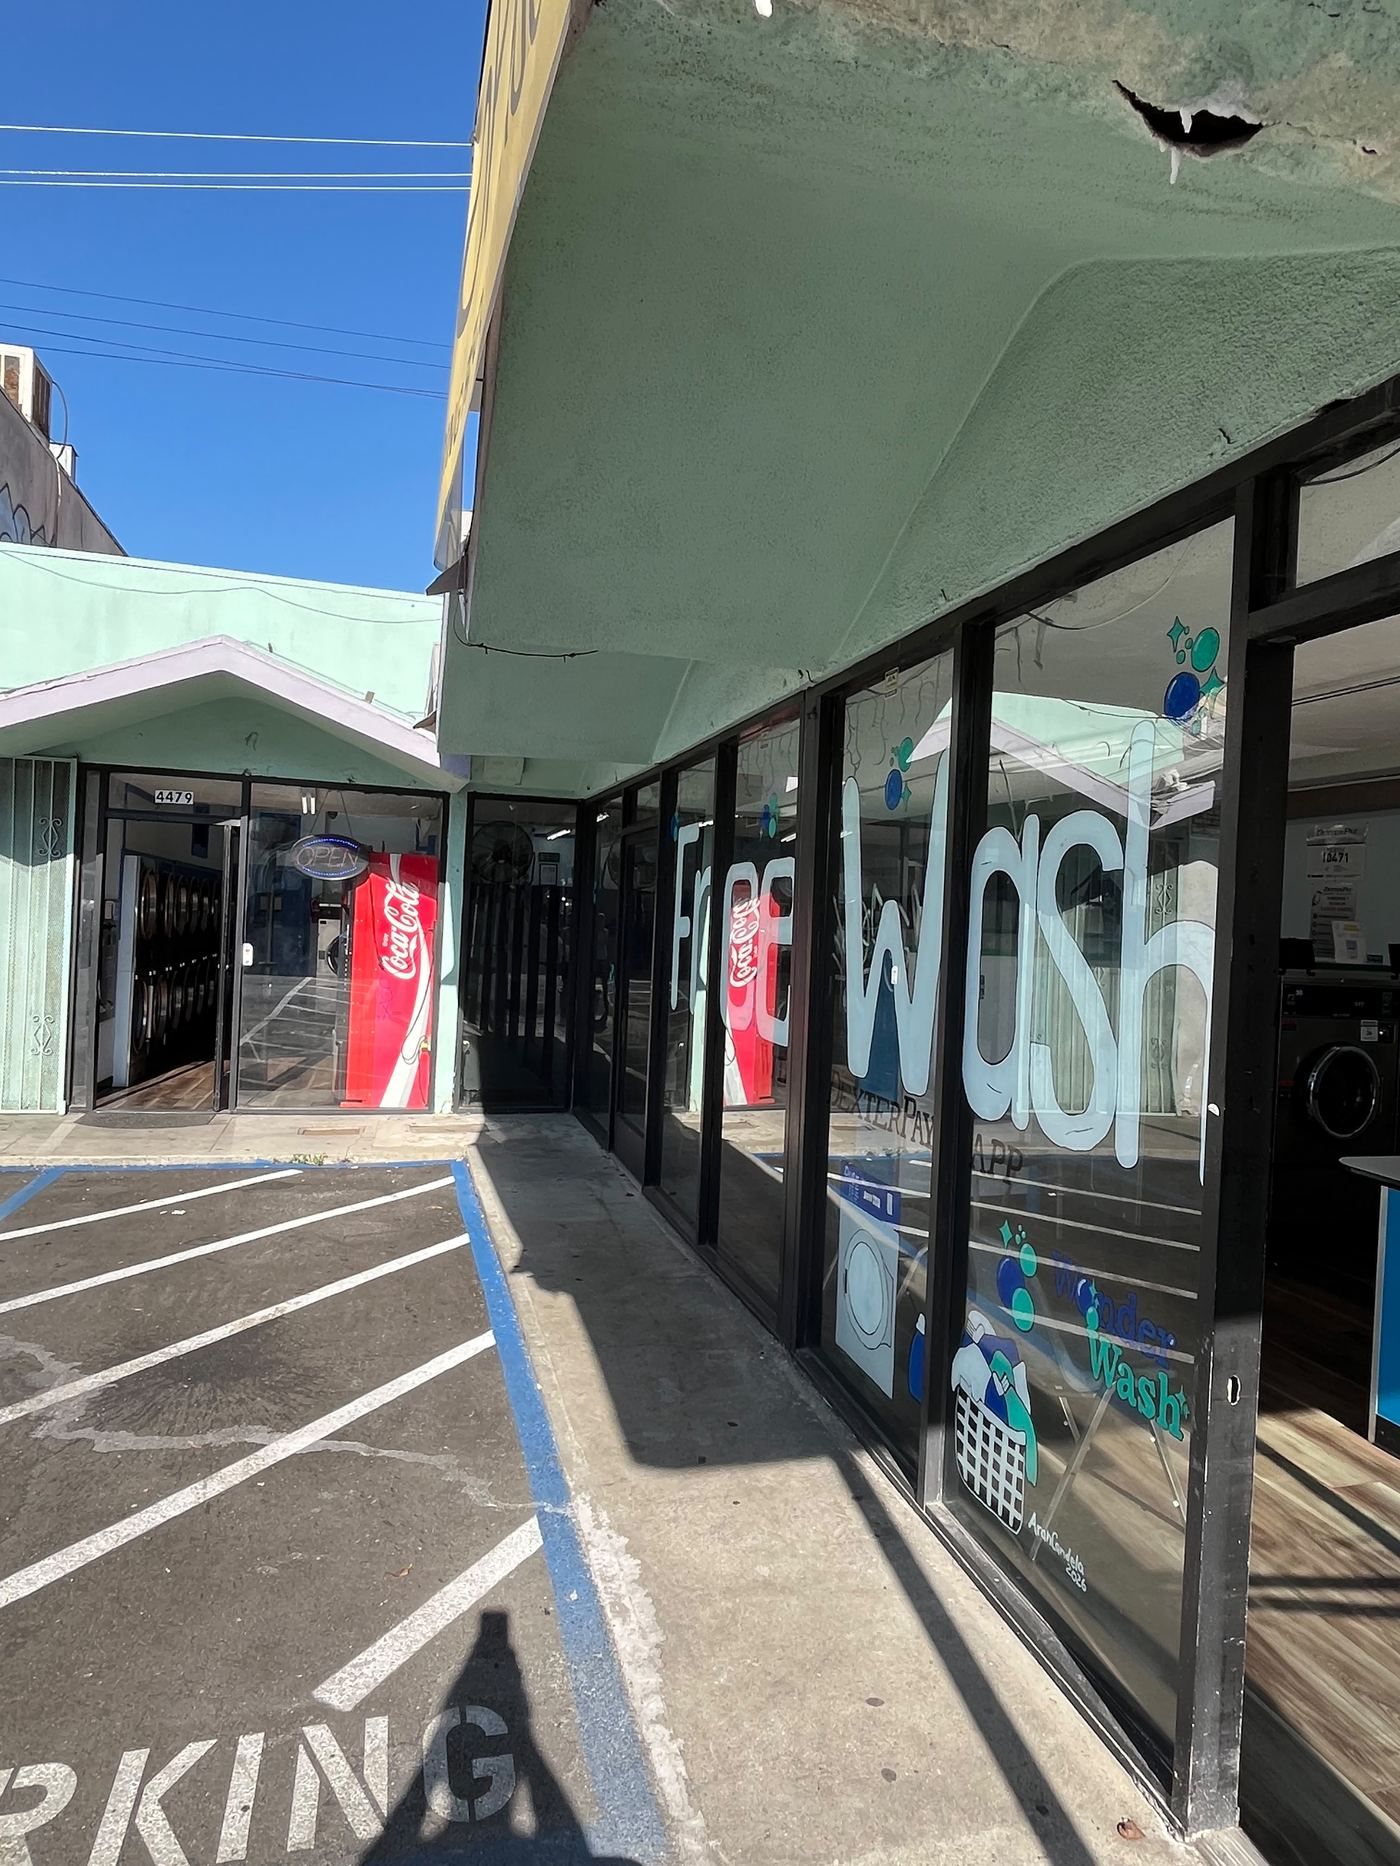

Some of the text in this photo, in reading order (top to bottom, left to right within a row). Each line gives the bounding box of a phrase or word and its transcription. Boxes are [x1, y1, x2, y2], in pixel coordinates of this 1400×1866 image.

[156, 791, 193, 803] 4479
[297, 846, 358, 868] OPEN
[670, 718, 1221, 1187] Free Wash
[972, 1132, 1024, 1185] APP
[1052, 1250, 1177, 1369] Wonder
[1086, 1320, 1184, 1441] Wash
